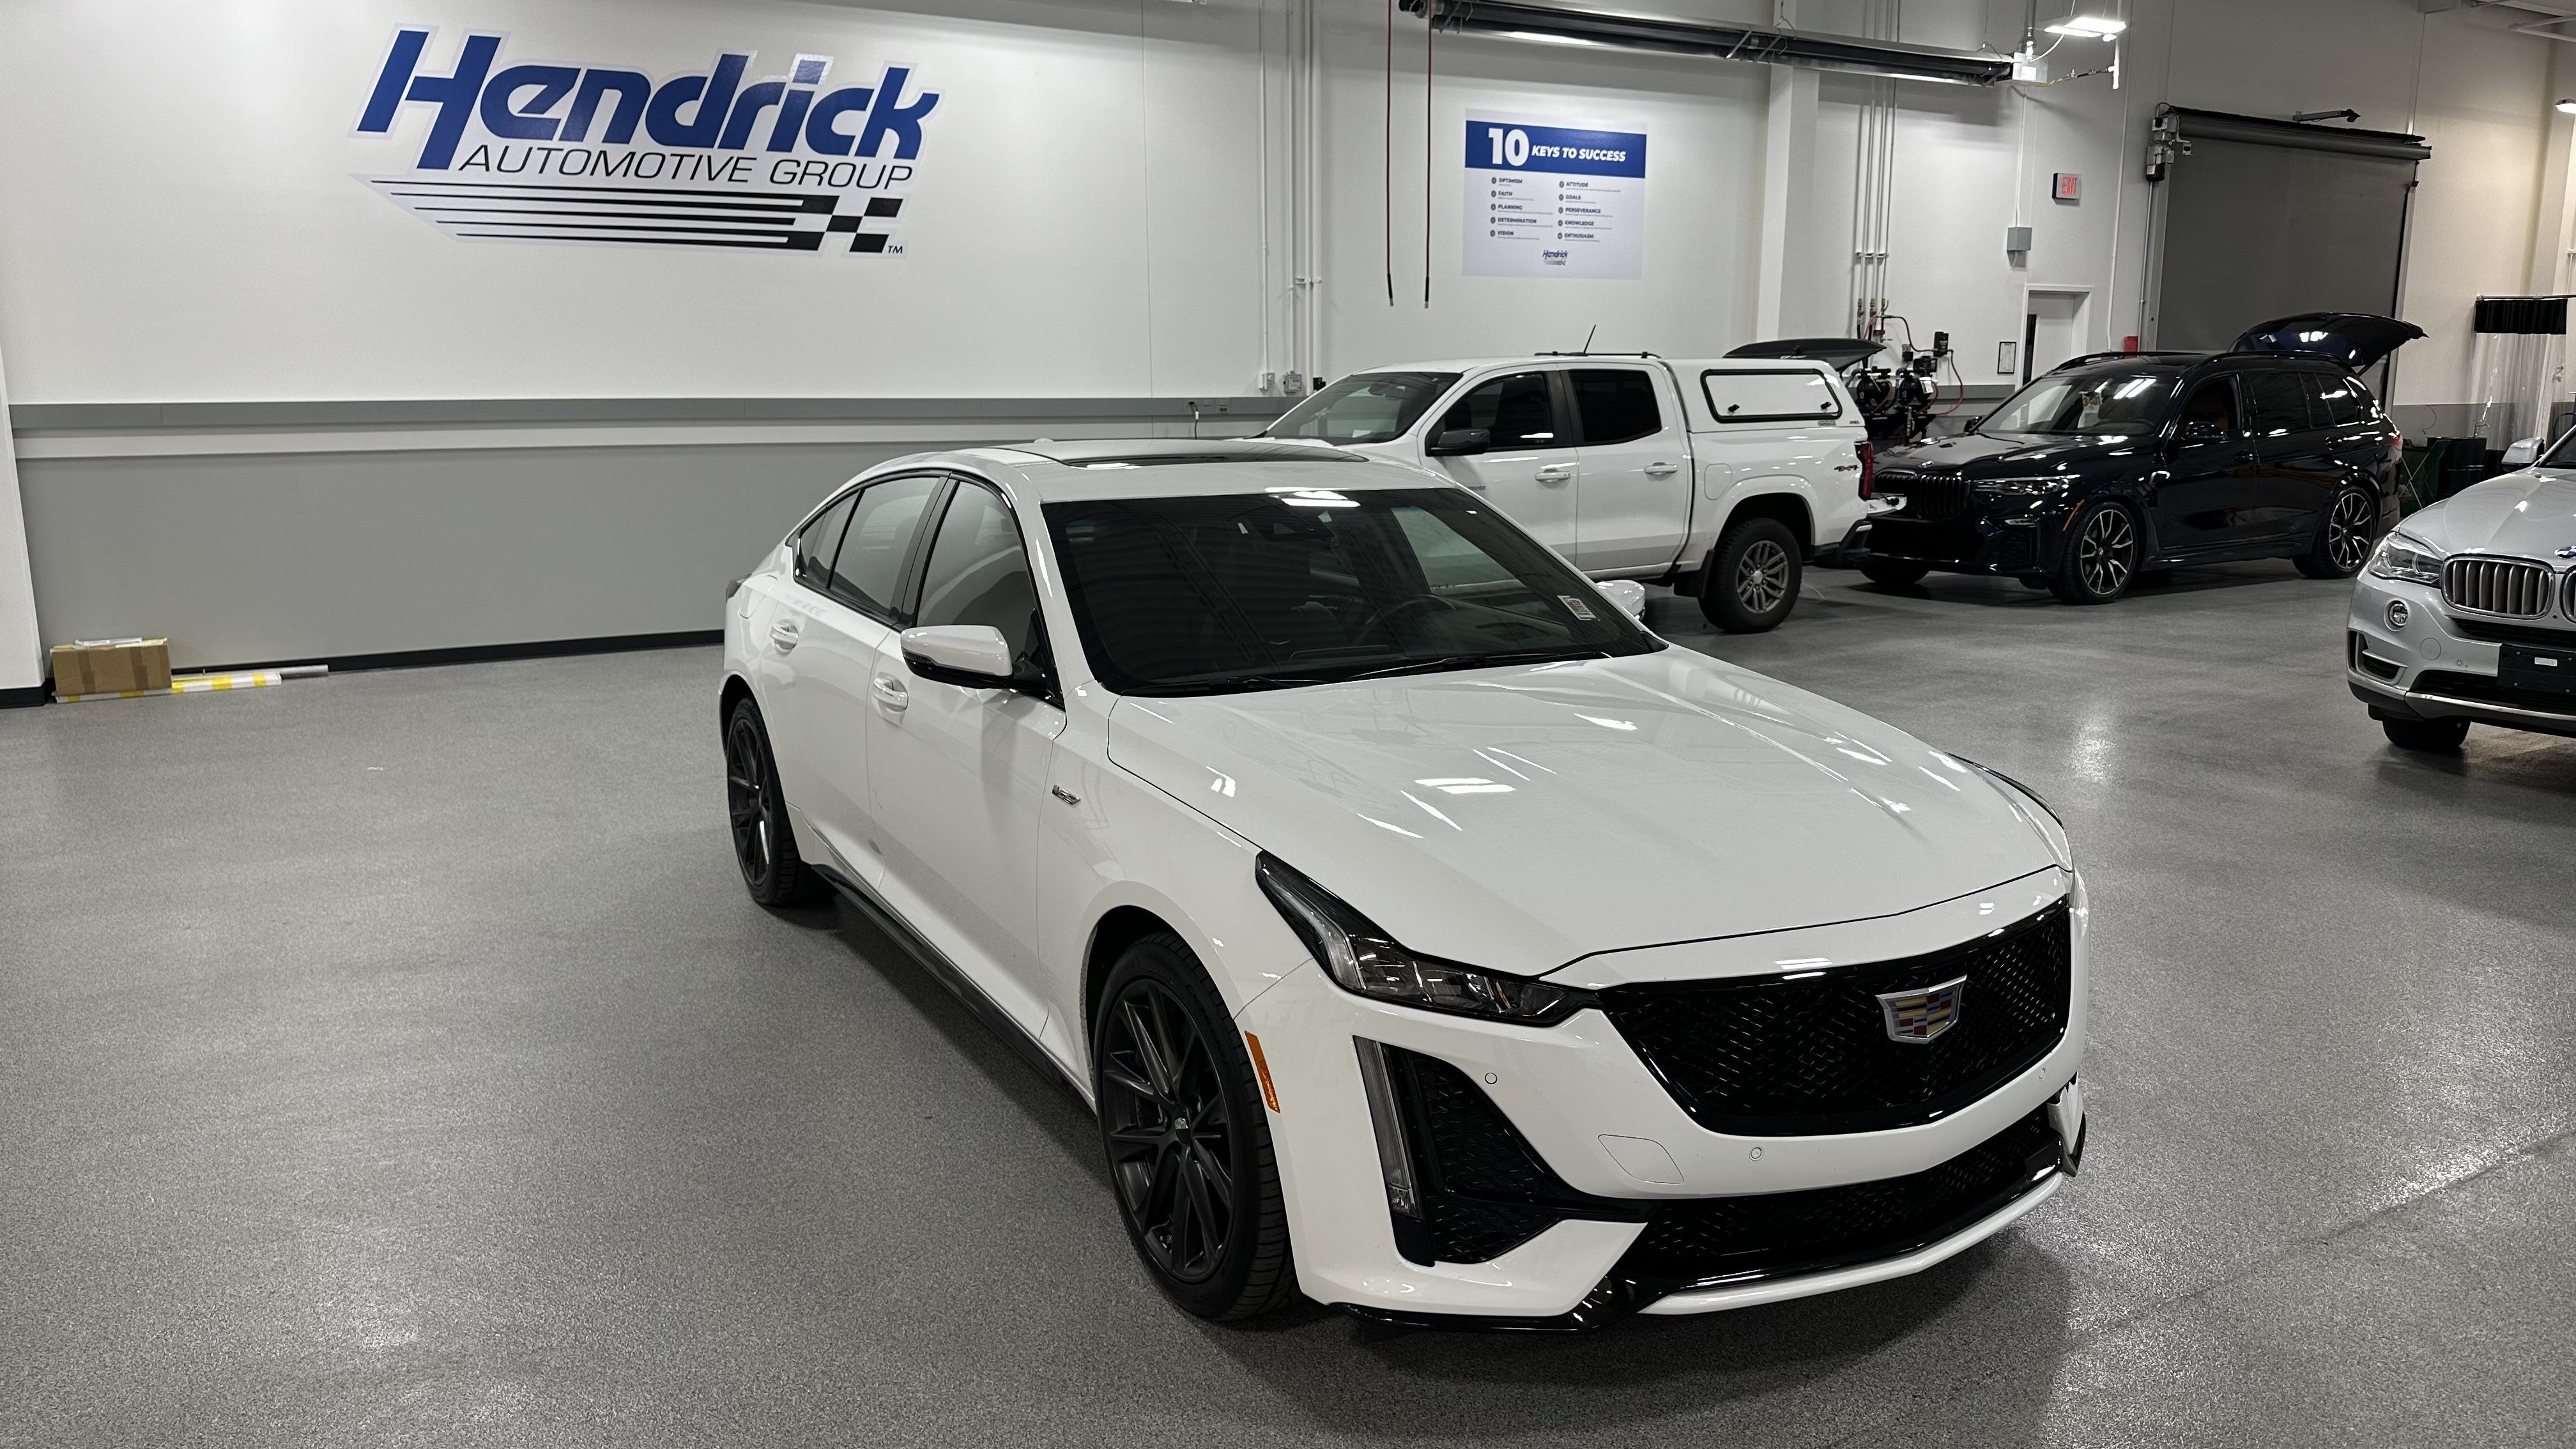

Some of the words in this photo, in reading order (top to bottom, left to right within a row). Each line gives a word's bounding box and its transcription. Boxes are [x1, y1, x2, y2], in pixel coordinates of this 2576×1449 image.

[356, 29, 940, 171] Hendrick
[459, 144, 757, 184] AUTOMOTIVE
[769, 158, 912, 190] GROUP
[1488, 127, 1529, 166] 10
[1531, 145, 1560, 158] KEYS
[1562, 147, 1577, 158] TO
[1579, 148, 1626, 162] SUCCESS
[888, 245, 903, 254] TM
